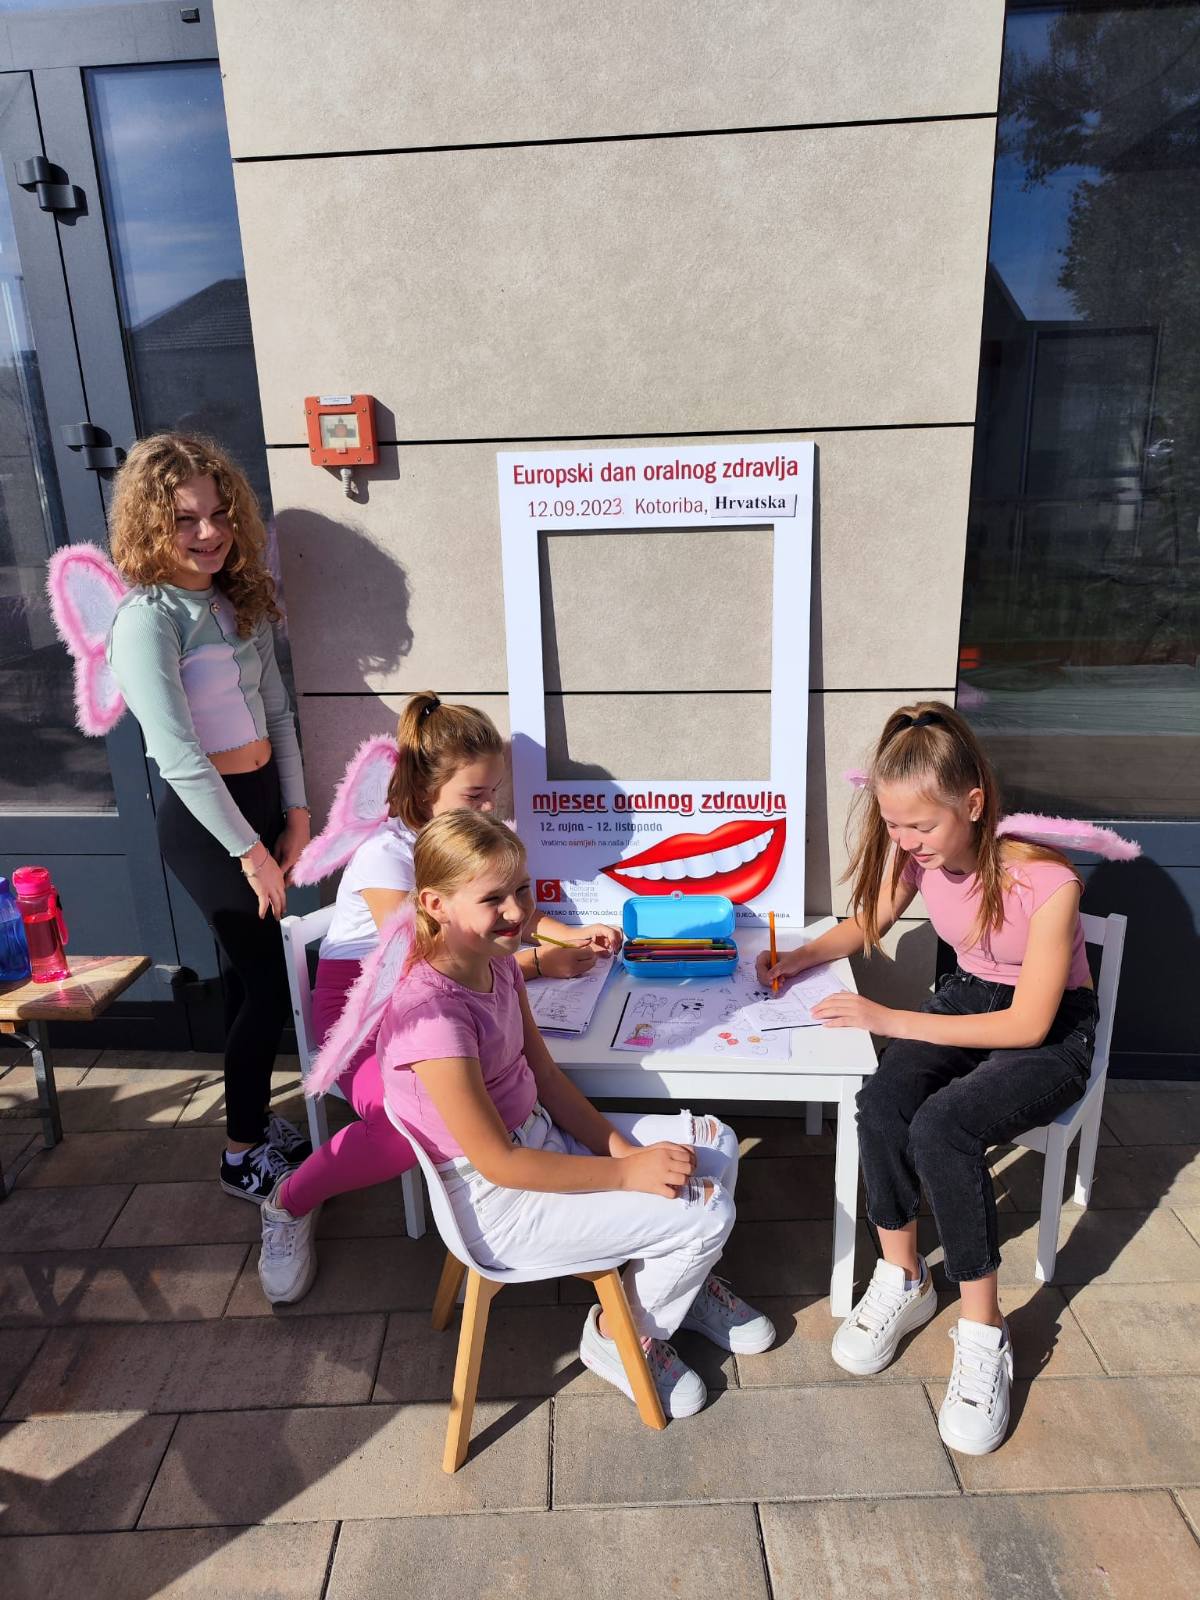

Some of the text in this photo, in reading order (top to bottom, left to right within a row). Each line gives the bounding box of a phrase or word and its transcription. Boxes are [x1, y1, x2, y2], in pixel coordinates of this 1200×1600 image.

[513, 456, 798, 488] Europski dan oralnog zdravlja
[635, 497, 708, 516] Kotoriba,
[715, 495, 786, 510] Hrvatska
[532, 791, 787, 815] mjesec oralnog zdravlja
[540, 822, 555, 832] 12.
[558, 822, 585, 833] rujna
[597, 822, 612, 832] 12.
[615, 822, 663, 833] listopada
[568, 839, 596, 848] osmijeh
